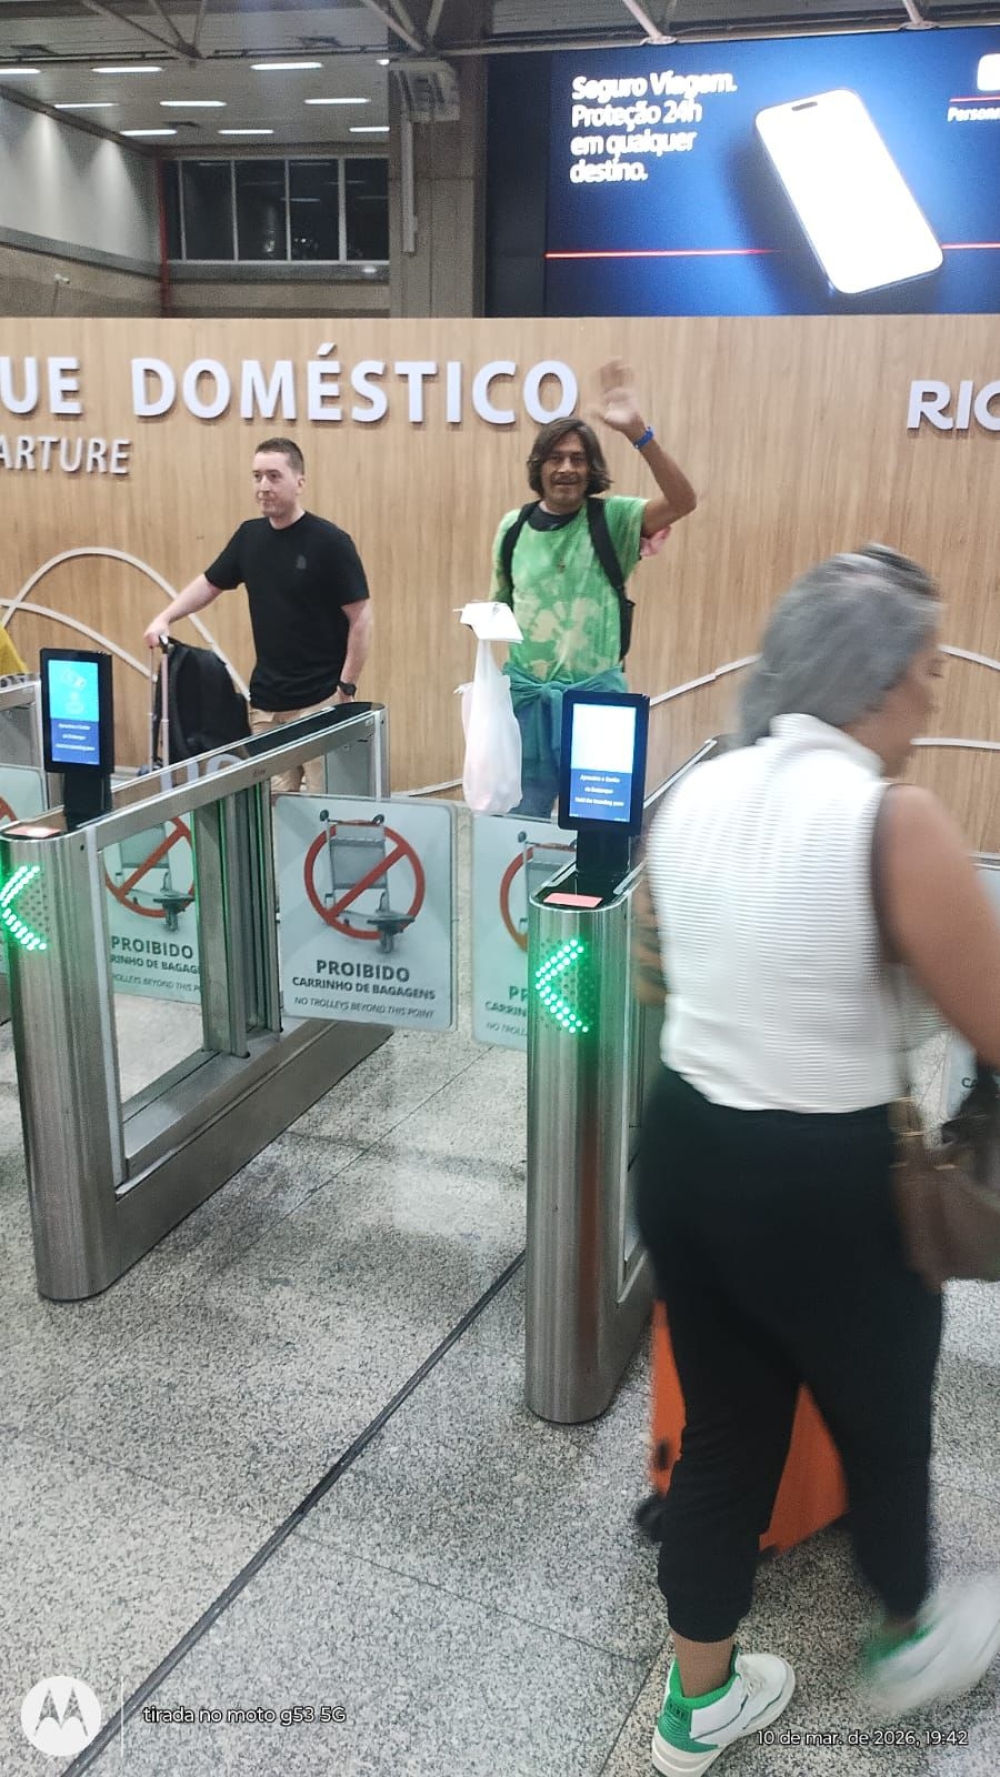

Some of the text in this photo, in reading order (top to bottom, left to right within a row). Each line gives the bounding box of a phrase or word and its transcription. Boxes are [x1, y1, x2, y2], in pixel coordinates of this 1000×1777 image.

[572, 76, 648, 103] Seguro
[572, 98, 702, 132] Proteção 24h
[570, 129, 697, 162] em qualquer
[570, 159, 648, 183] destino.
[131, 342, 579, 425] DOMÉSTICO
[111, 935, 194, 960] PROIBIDO
[146, 959, 159, 969] DE
[316, 959, 410, 983] PROIBIDO
[292, 976, 436, 1000] CARRINHO DE BAGAGENS
[294, 996, 435, 1019] NO TROLLEYS BEYOND THIS POINT
